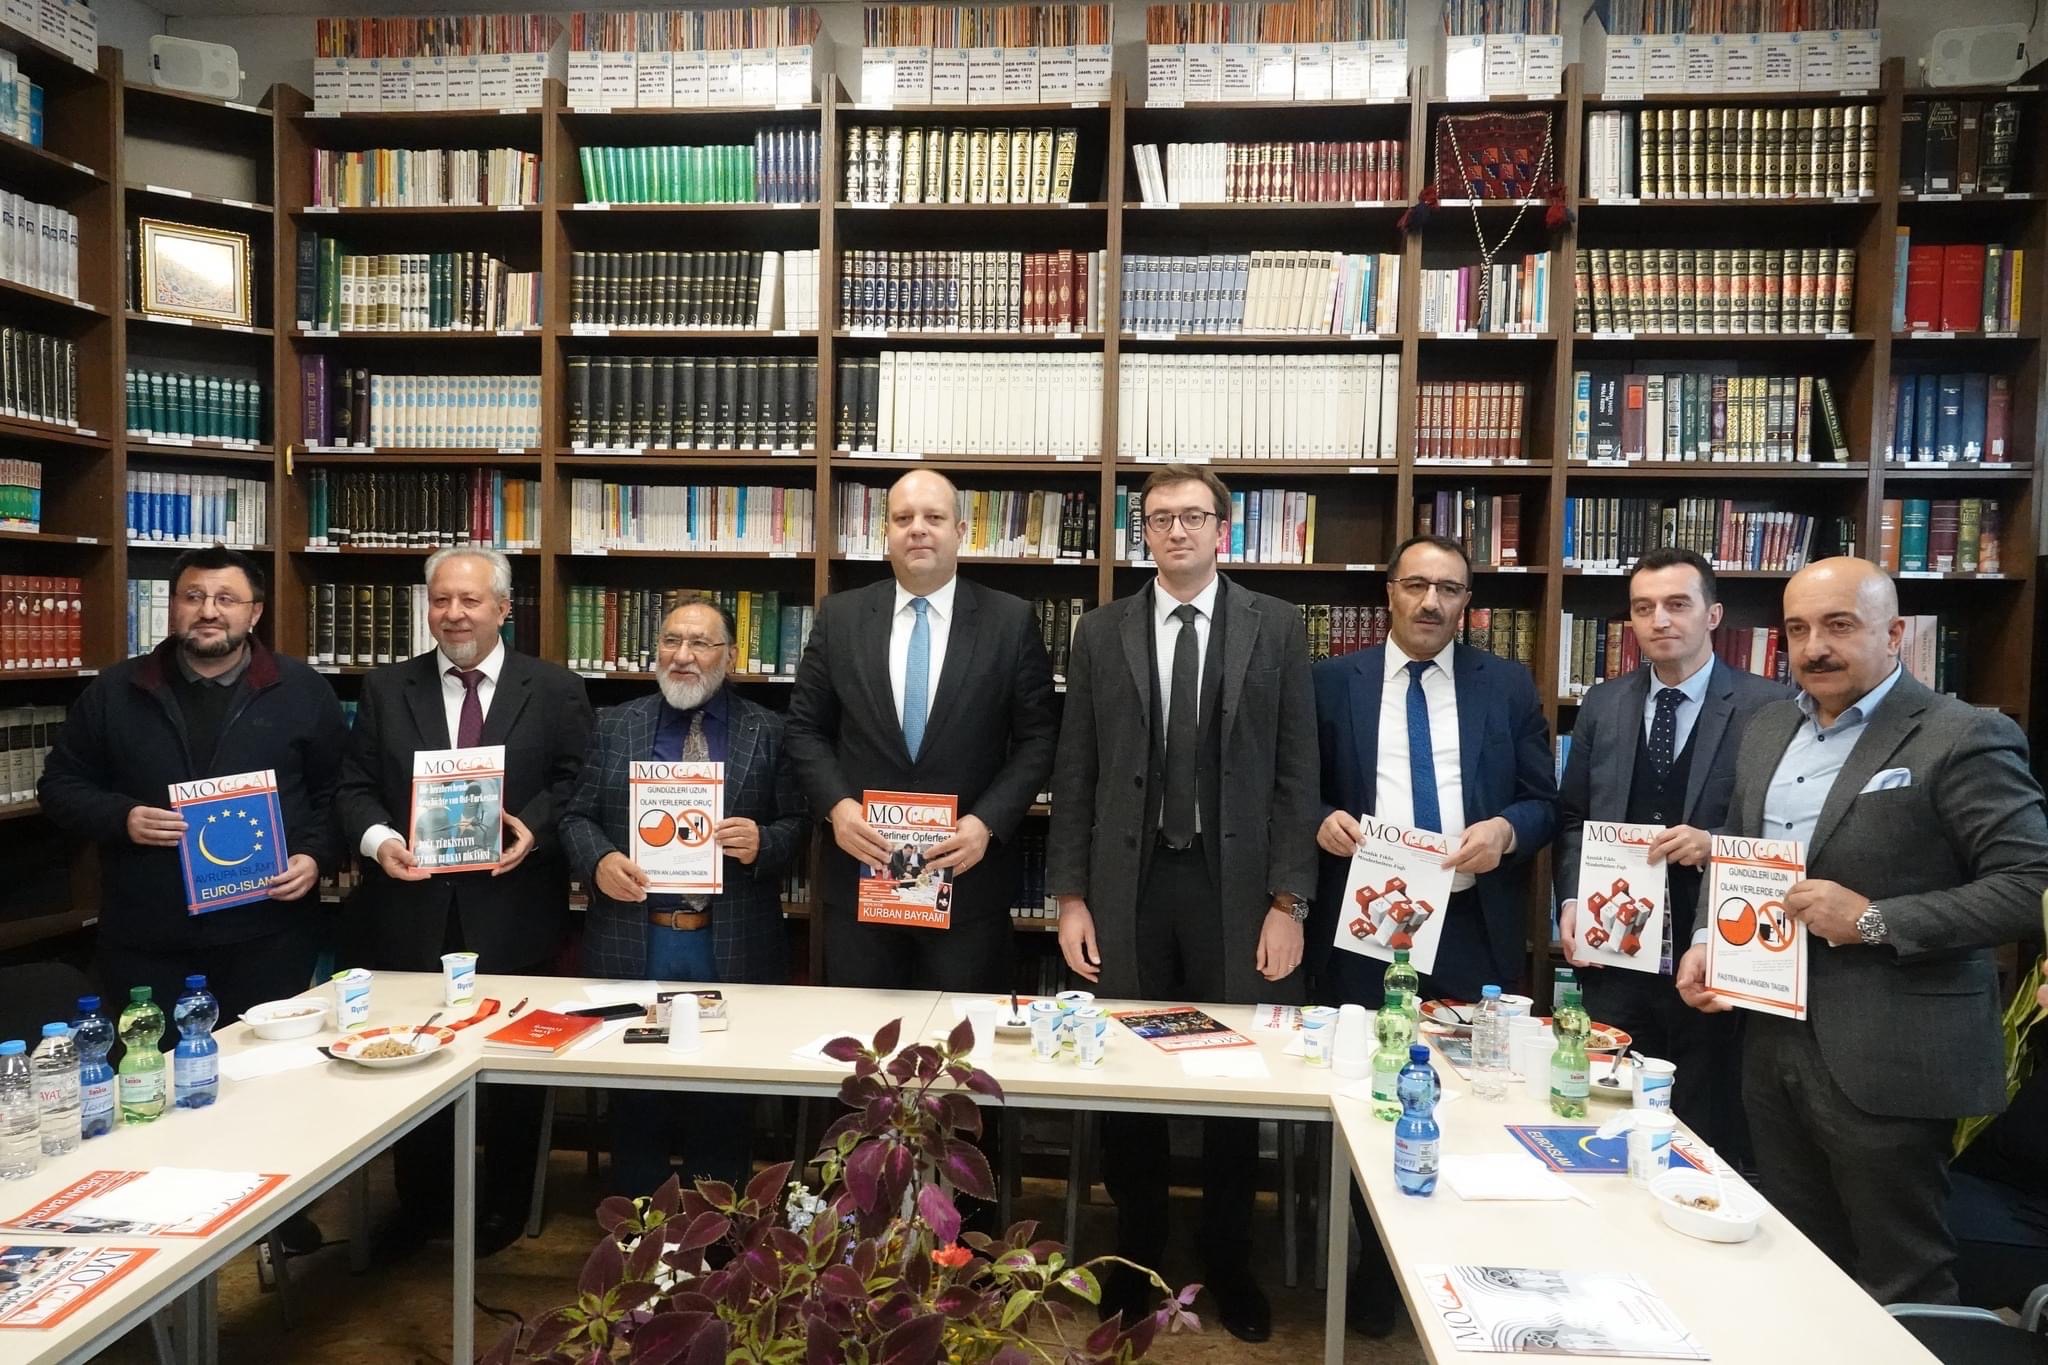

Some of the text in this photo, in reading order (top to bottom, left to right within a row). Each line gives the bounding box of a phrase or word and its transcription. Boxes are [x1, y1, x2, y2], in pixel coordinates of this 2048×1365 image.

[638, 763, 713, 780] MOCCA
[179, 775, 264, 801] MOCCA
[690, 786, 708, 794] UZUN
[640, 798, 658, 806] OLAN
[658, 799, 693, 807] YERLERDE
[868, 804, 950, 827] MOCCA
[1364, 819, 1449, 856] MOCCA
[1719, 838, 1793, 864] MOCCA
[1771, 871, 1788, 882] UZUN
[1740, 884, 1774, 897] YERLERDE
[863, 907, 945, 923] KURBAN BAYRAMI
